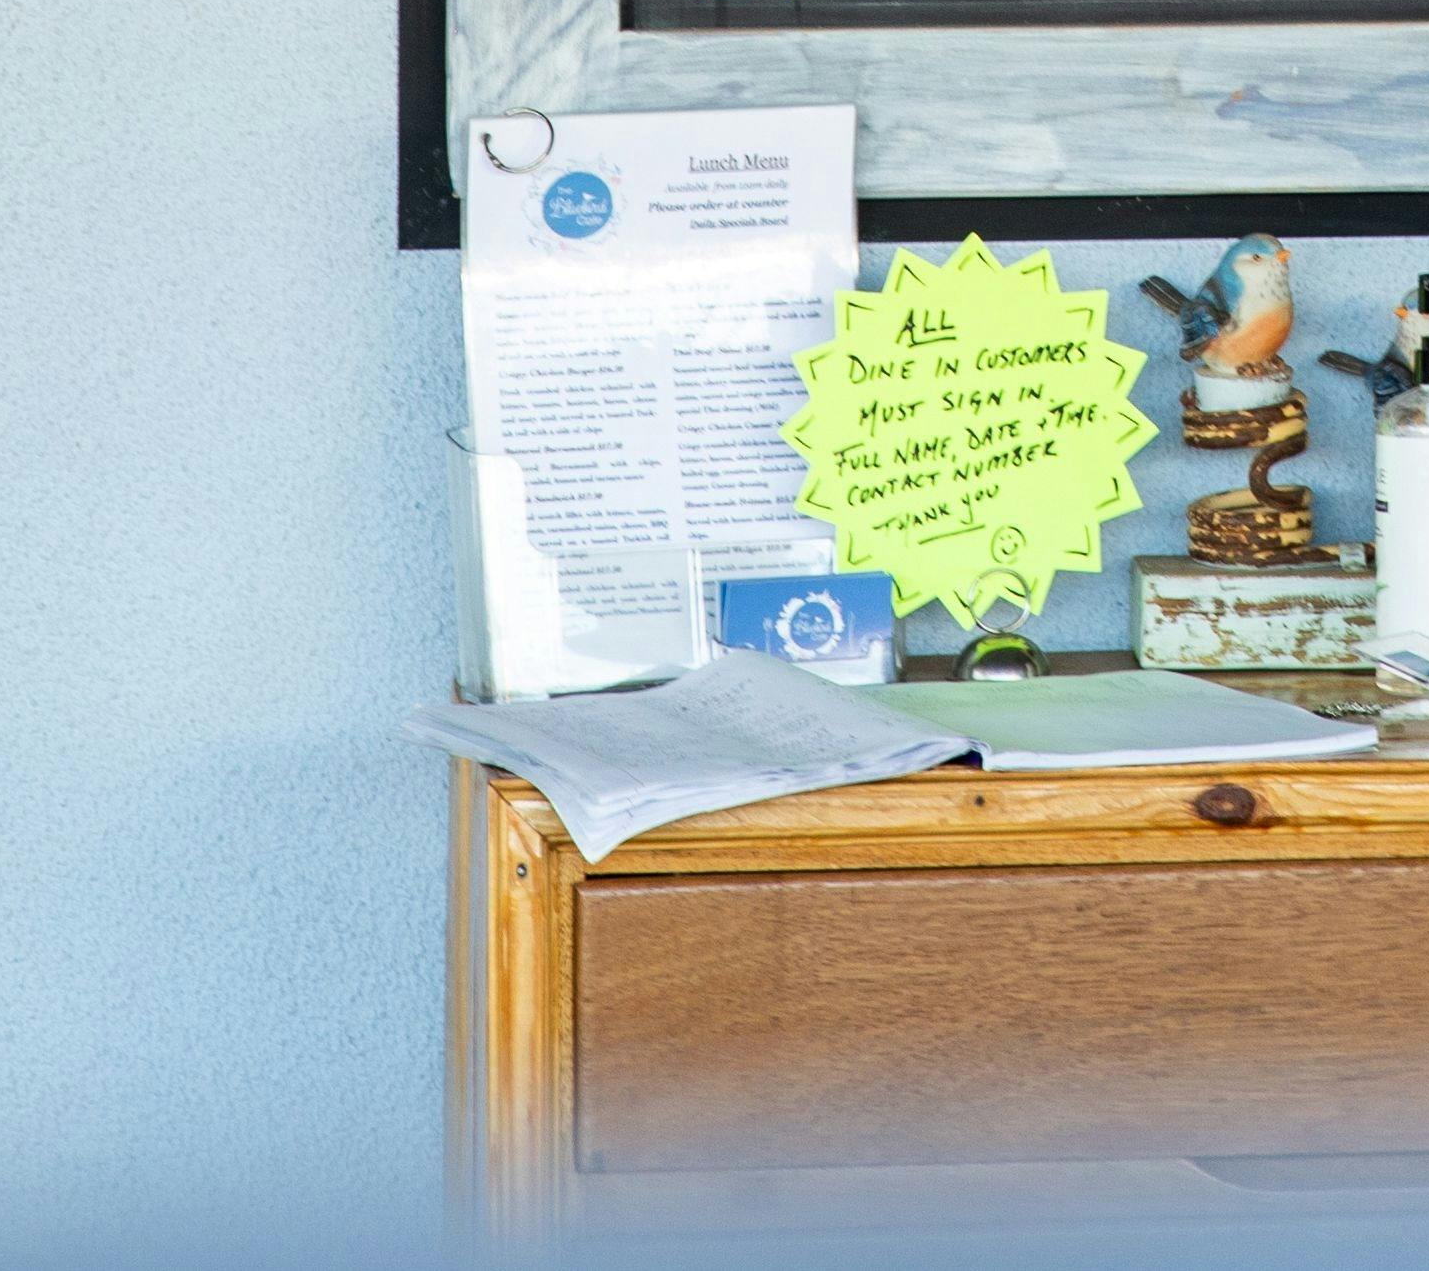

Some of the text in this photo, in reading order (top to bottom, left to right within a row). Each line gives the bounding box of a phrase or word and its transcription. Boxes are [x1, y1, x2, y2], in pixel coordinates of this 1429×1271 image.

[688, 152, 790, 171] Lunch Menu
[647, 197, 789, 213] Please order at counter
[896, 308, 956, 345] ALL
[846, 340, 1089, 385] DINE IN CUSTOMERS
[858, 399, 926, 438] MUST
[941, 388, 1005, 417] SIGN
[833, 442, 883, 477] FULL
[964, 419, 1021, 451] DATE
[846, 471, 942, 507] CONTACT
[952, 439, 1059, 482] NUMBER
[872, 501, 951, 548] THANK
